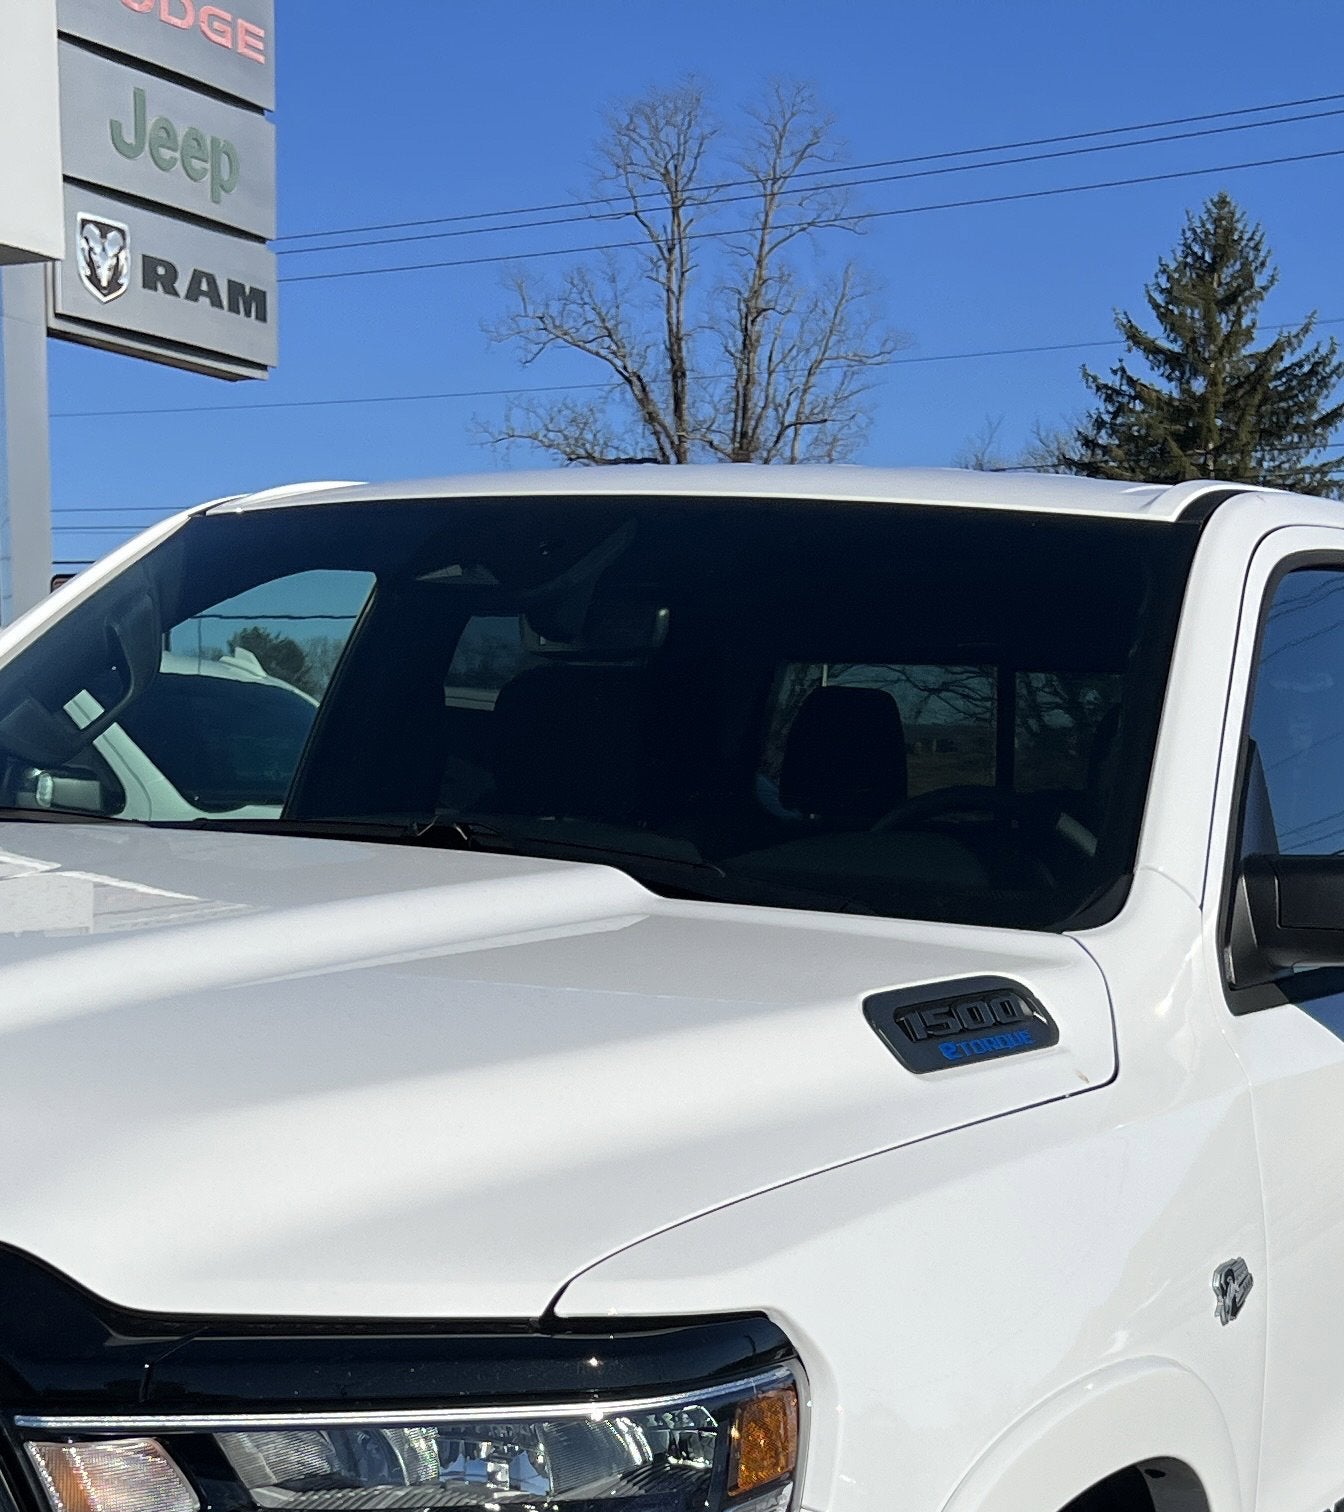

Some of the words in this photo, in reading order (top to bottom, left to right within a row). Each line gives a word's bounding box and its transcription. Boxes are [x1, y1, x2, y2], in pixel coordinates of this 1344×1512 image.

[109, 86, 241, 205] Jeep
[141, 253, 268, 323] RAM
[896, 993, 1025, 1043] 1500
